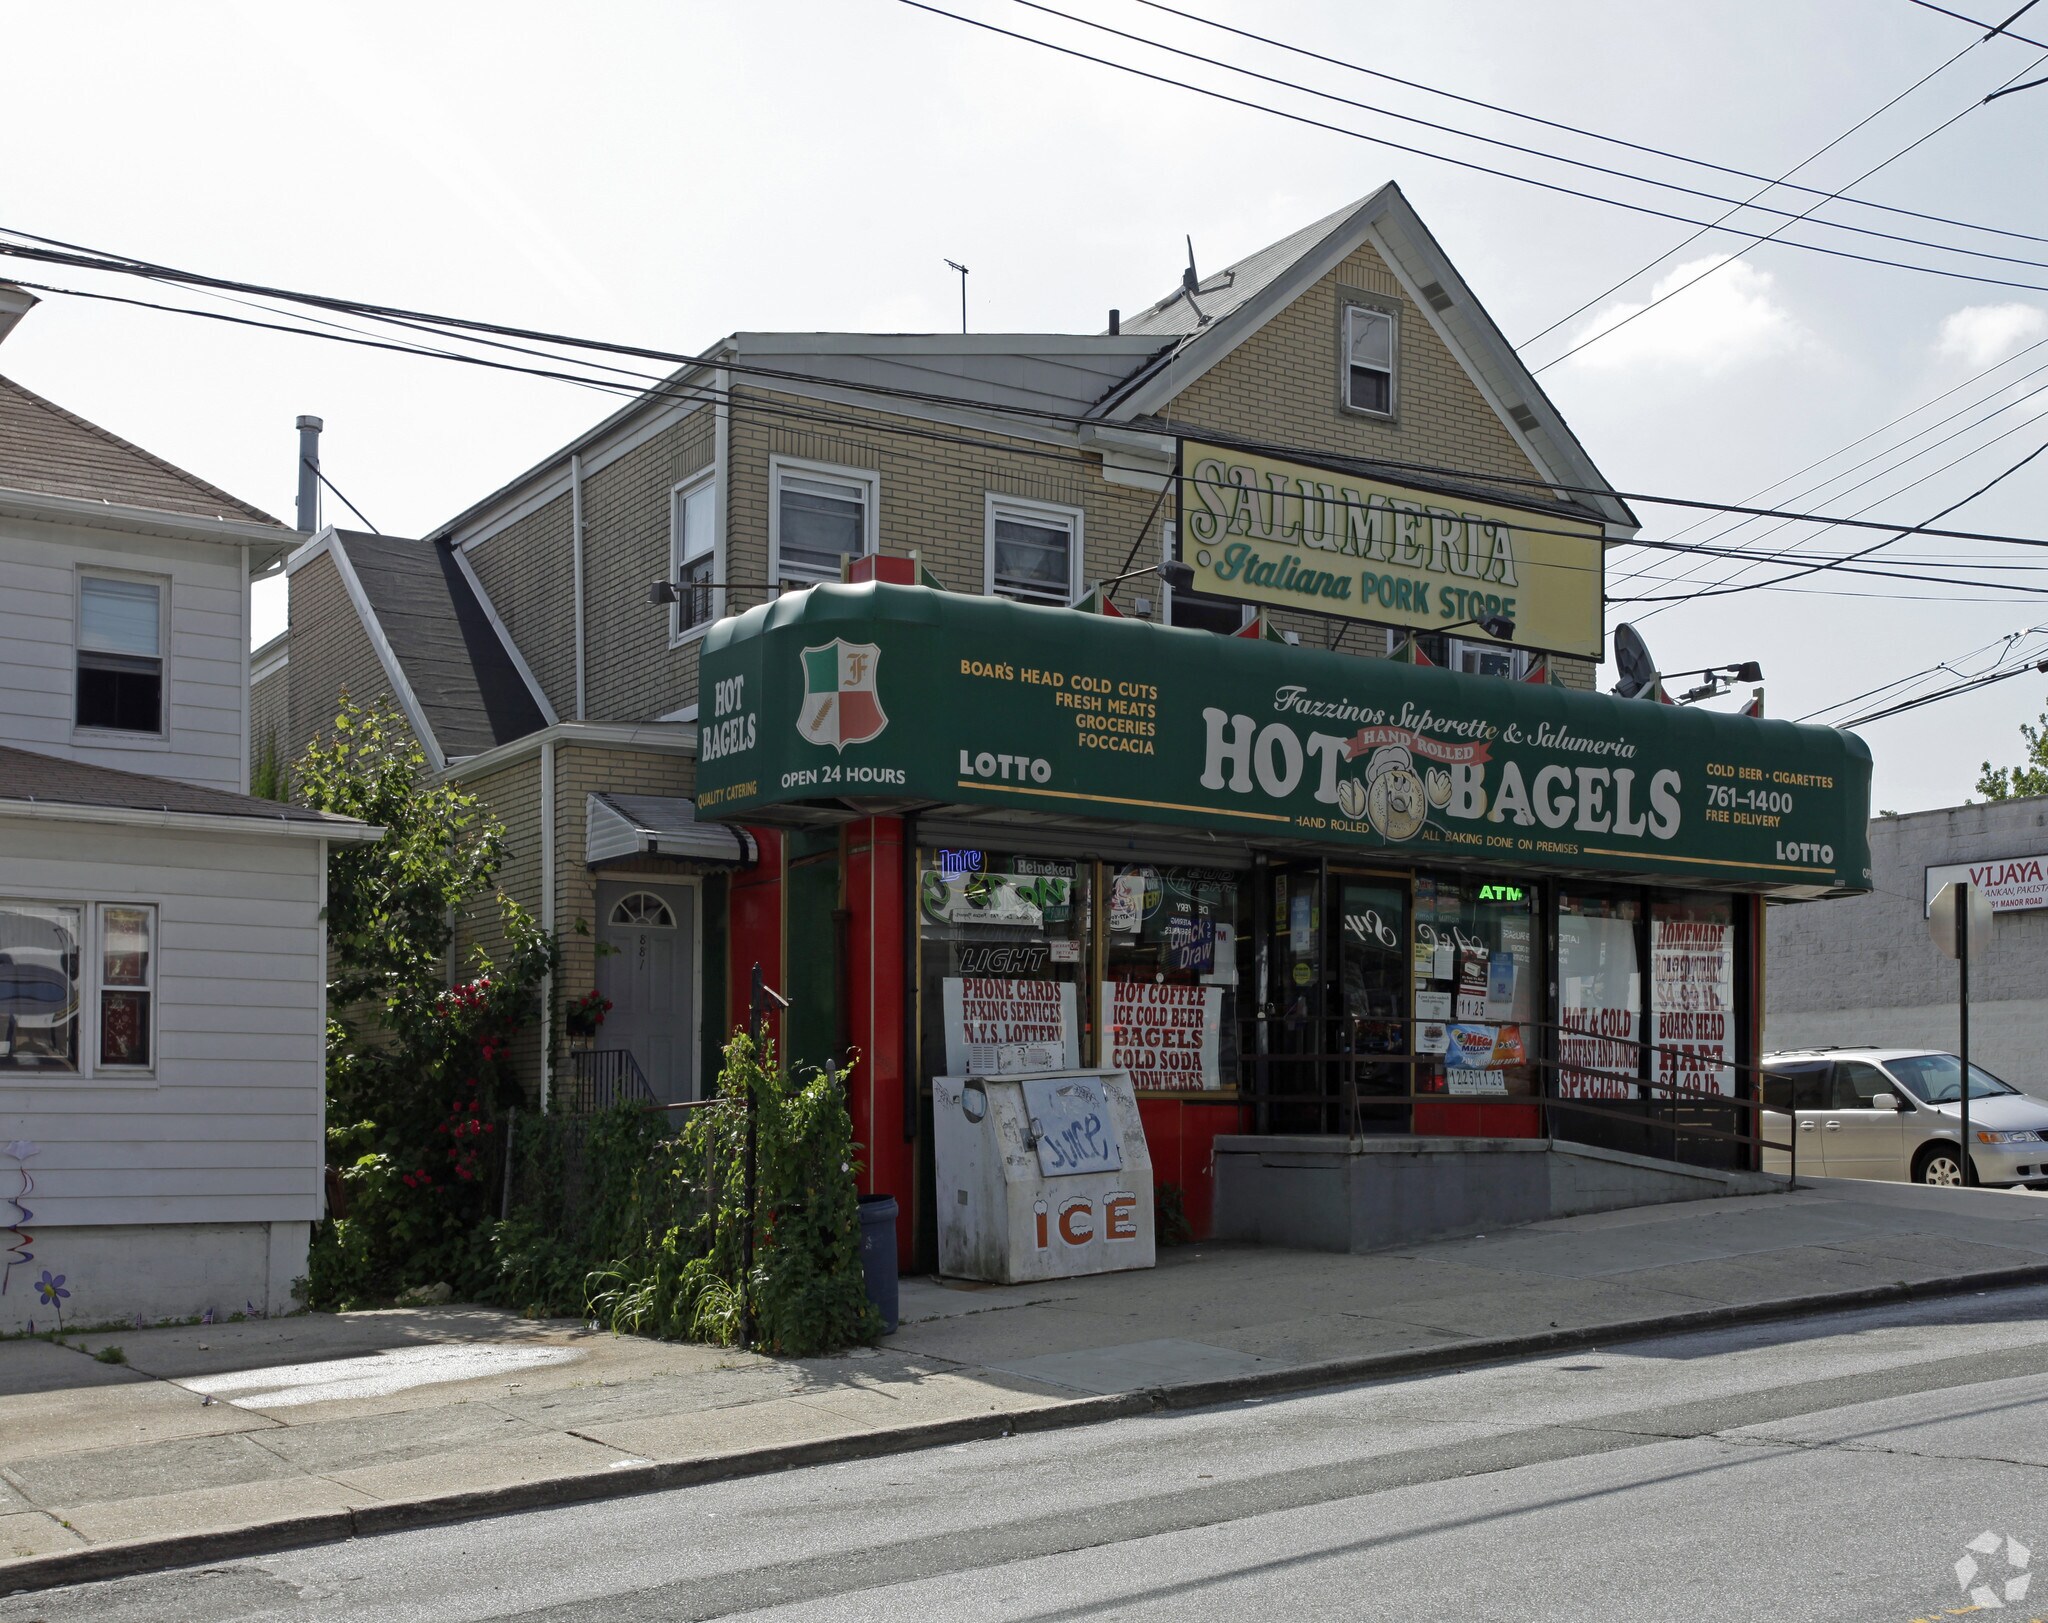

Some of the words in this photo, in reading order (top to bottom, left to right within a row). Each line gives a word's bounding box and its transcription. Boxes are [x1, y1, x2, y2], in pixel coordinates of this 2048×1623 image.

[1190, 457, 1519, 588] SALUMERIA
[1215, 542, 1353, 599] Italiana
[1361, 571, 1430, 614] PORK
[960, 658, 1014, 681] BOAR'S
[1020, 668, 1064, 688] HEAD
[1071, 671, 1112, 694] COLD
[1118, 681, 1158, 701] CUTS
[714, 674, 745, 718] HOT
[1055, 691, 1101, 713] FRESH
[1105, 698, 1156, 718] MEATS
[1075, 713, 1156, 737] GROCERIES
[1274, 685, 1383, 726] Fazzinos
[1389, 701, 1500, 741] Superette
[1503, 724, 1524, 744] &
[1527, 721, 1638, 760] Salumeria
[702, 713, 756, 763] BAGELS
[1078, 732, 1155, 756] FOCCACIA
[1363, 729, 1412, 747] HAND
[1417, 737, 1474, 761] ROLLED
[781, 769, 818, 788] OPEN
[822, 765, 842, 783] 24
[846, 766, 906, 785] HOURS
[959, 749, 1052, 783] LOTTO
[1200, 707, 1352, 803] HOT
[1446, 759, 1682, 840] BAGELS
[1706, 763, 1734, 778] COLD
[1739, 766, 1763, 781] BEER
[1773, 771, 1833, 789] CIGARETTES
[698, 788, 724, 809] QUALITY
[726, 780, 757, 800] CATERING
[1706, 784, 1793, 814] 761-1400
[1706, 809, 1730, 823] FREE
[1733, 812, 1781, 828] DELIVERY
[1331, 818, 1370, 834] ROLLED
[1422, 829, 1439, 841] ALL
[1445, 831, 1483, 846] BAKING
[1486, 836, 1513, 849] DONE
[1518, 838, 1533, 851] ON
[1536, 839, 1579, 855] PREMISES
[1776, 841, 1834, 864] LOTTO
[1018, 859, 1073, 877] Heineken
[1969, 861, 2043, 887] VIJAYA
[1478, 885, 1523, 901] ATM
[2000, 898, 2024, 907] MANOR
[2025, 897, 2043, 906] ROAD
[1171, 920, 1206, 950] Quick
[1656, 923, 1725, 951] HOMEMADE
[959, 948, 1049, 973] LIGHT
[1180, 941, 1213, 970] Draw
[962, 977, 1014, 1000] PHONE
[1017, 979, 1061, 1002] CARDS
[1114, 982, 1145, 1004] HOT
[1149, 985, 1206, 1007] COFFEE
[962, 1000, 1009, 1021] FAXING
[1010, 1002, 1062, 1024] SERVICES
[1113, 1006, 1133, 1025] ICE
[1136, 1006, 1168, 1027] COLD
[1170, 1008, 1204, 1028] BEER
[1562, 1007, 1587, 1034] HOT
[1590, 1007, 1599, 1034] &
[1601, 1008, 1632, 1037] COLD
[963, 1024, 1003, 1044] N.Y.S.
[1005, 1025, 1063, 1043] LOTTERY
[1113, 1027, 1203, 1050] BAGELS
[1659, 1012, 1693, 1040] BOARS
[1696, 1013, 1725, 1041] HEAD
[1112, 1049, 1156, 1070] COLD
[1160, 1051, 1201, 1071] SODA
[1598, 1039, 1613, 1068] AND
[1659, 1044, 1724, 1072] HAM
[1561, 1068, 1629, 1100] SPECIALS
[1032, 1190, 1138, 1251] ICE
